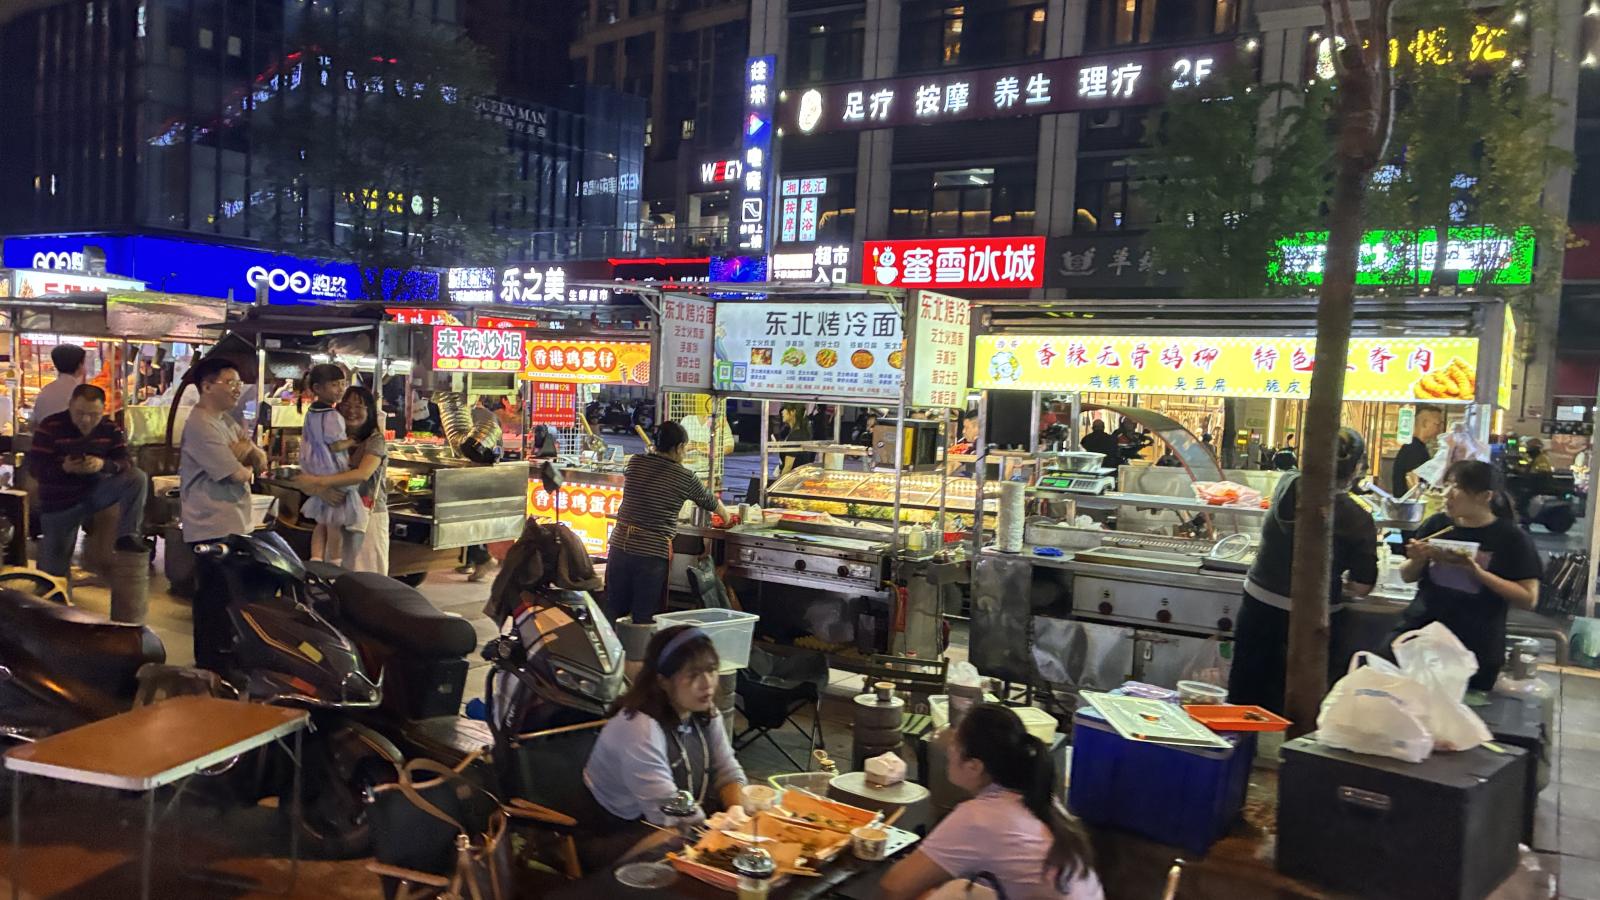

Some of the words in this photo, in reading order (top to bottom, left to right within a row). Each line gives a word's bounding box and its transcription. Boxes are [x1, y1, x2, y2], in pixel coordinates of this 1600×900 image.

[843, 88, 894, 120] 足疗
[915, 82, 969, 114] 按摩
[994, 72, 1051, 109] 养生
[1078, 63, 1143, 98] 理疗
[1171, 58, 1213, 89] 2F
[785, 200, 796, 232] 按摩
[802, 200, 815, 231] 足浴
[815, 245, 849, 266] 超市
[902, 243, 1037, 284] 蜜雪冰城
[500, 266, 565, 302] 乐之美
[814, 266, 847, 284] 入口
[664, 300, 714, 325] 东北烤冷面
[766, 311, 898, 338] 东北烤冷面
[438, 328, 522, 358] 来碗炒饭
[1036, 343, 1220, 371] 香辣无骨鸡柳
[1253, 345, 1434, 373] 特色脊肉
[533, 348, 616, 369] 香港鸡蛋仔
[1263, 378, 1311, 394] 脆皮
